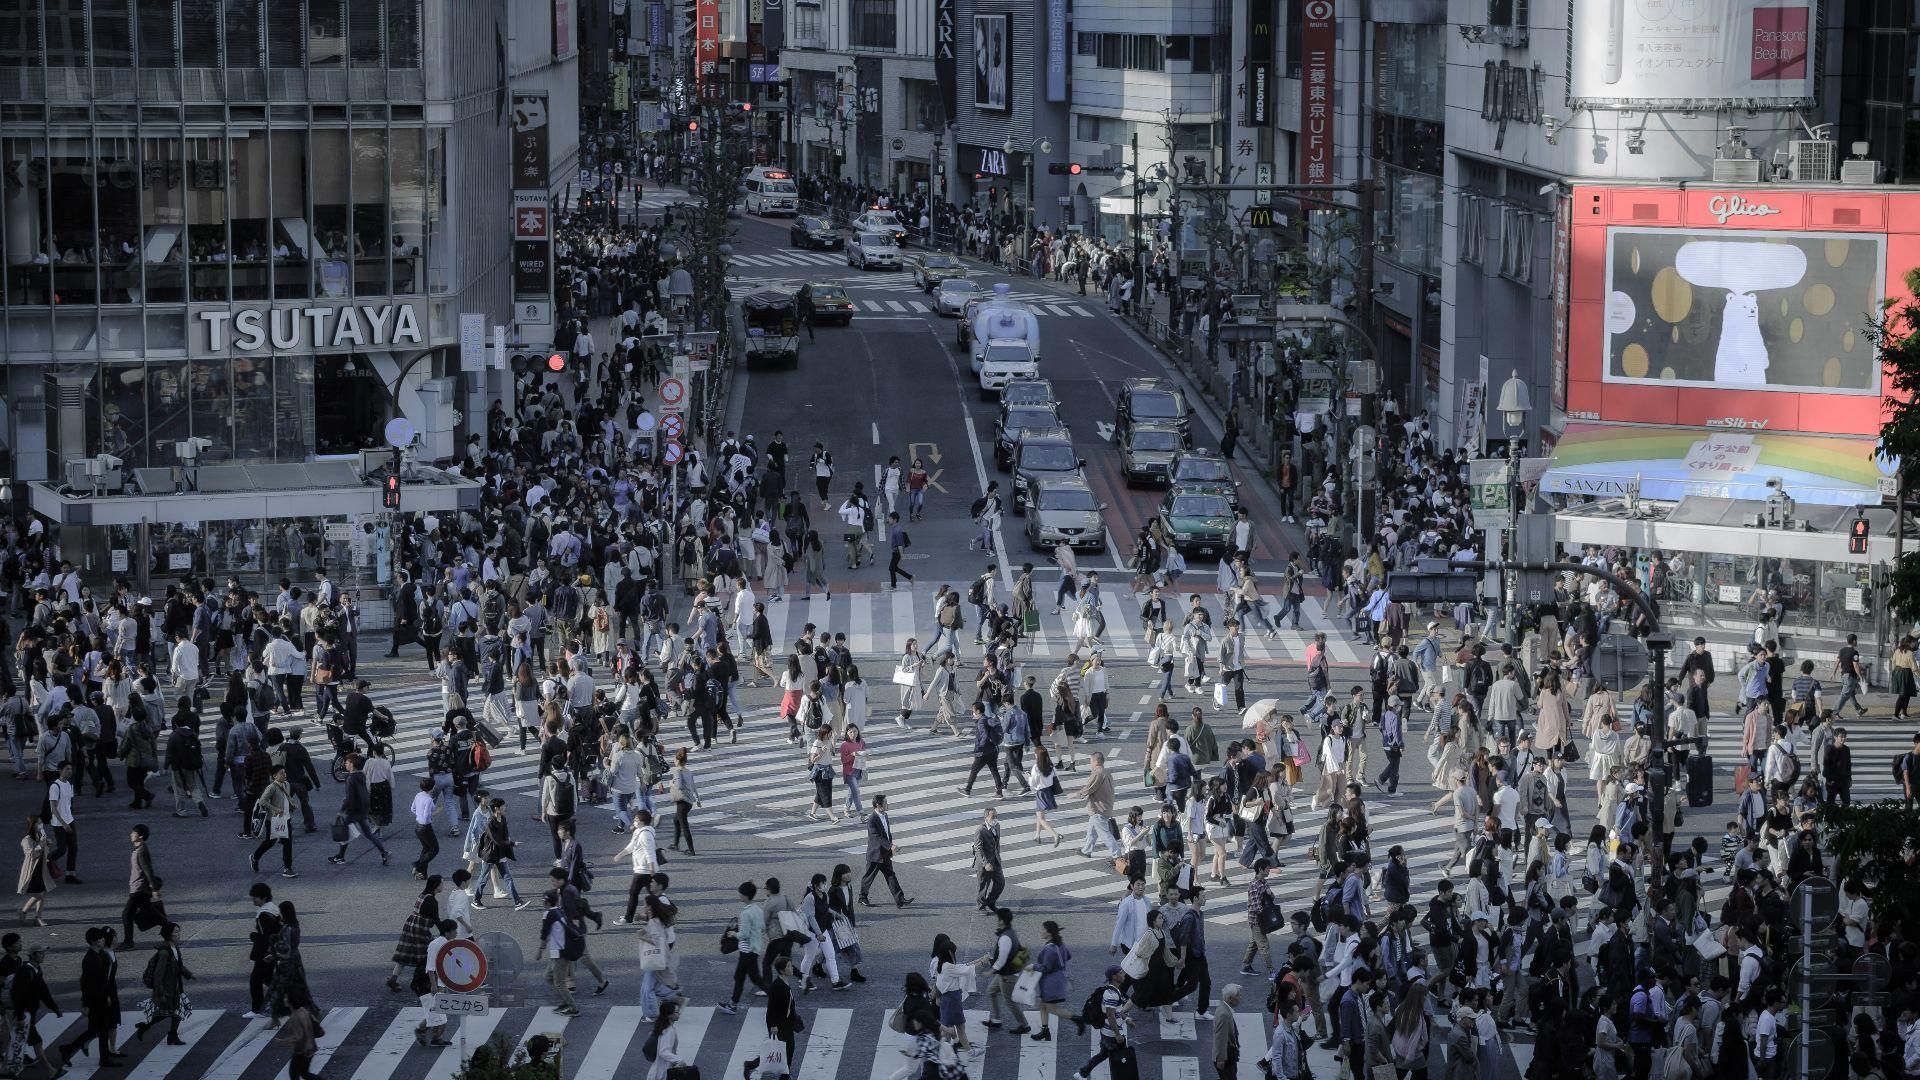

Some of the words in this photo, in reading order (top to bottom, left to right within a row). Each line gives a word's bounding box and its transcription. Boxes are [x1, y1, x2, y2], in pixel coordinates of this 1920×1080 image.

[1755, 28, 1807, 42] Panasonic
[1754, 46, 1793, 63] Beauty
[981, 149, 1007, 176] ZARA
[1708, 195, 1780, 225] Glico
[520, 210, 543, 233] 本
[519, 260, 545, 268] WIRED
[200, 304, 423, 352] TSUTAYA
[1700, 443, 1751, 454] ハチ公前
[439, 999, 484, 1012] ここから
